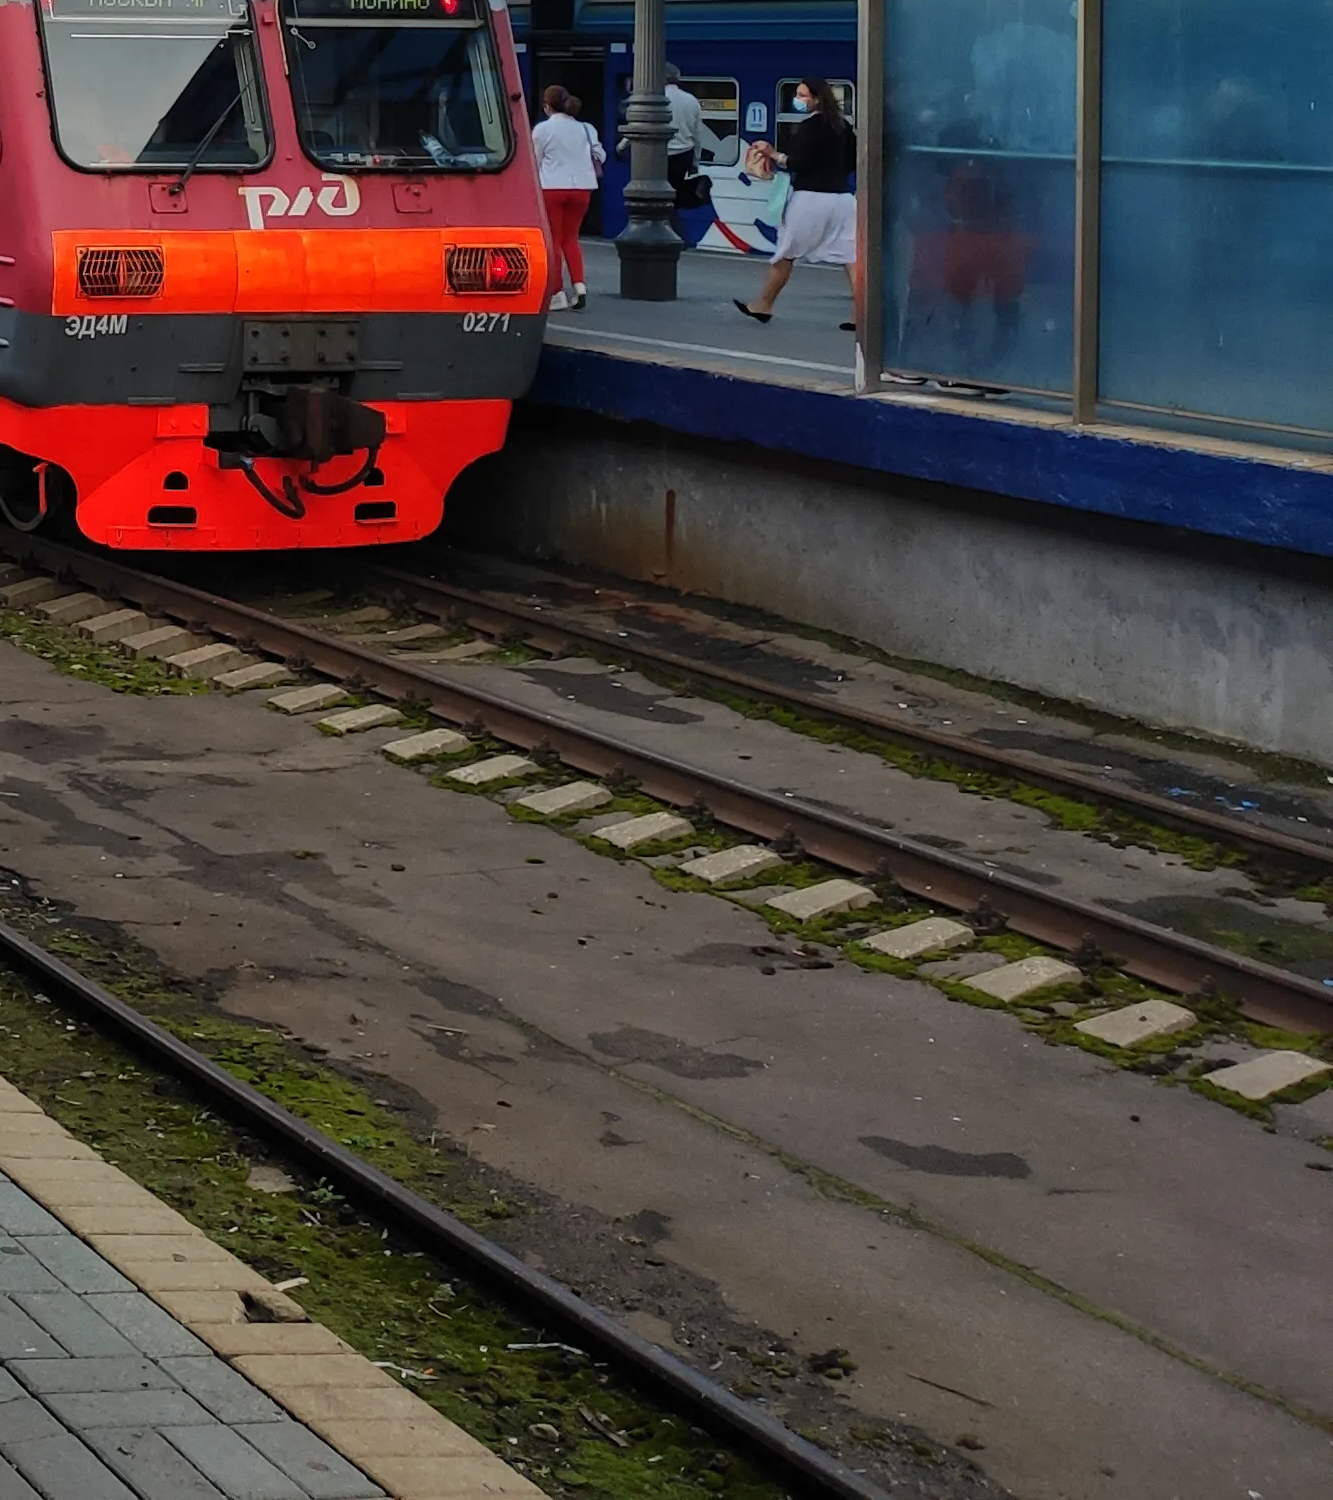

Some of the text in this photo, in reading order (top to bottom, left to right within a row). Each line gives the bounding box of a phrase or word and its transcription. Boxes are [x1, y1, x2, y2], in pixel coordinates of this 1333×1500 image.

[751, 108, 763, 123] 11
[64, 314, 128, 340] ЭД4М
[462, 312, 511, 333] 0271
